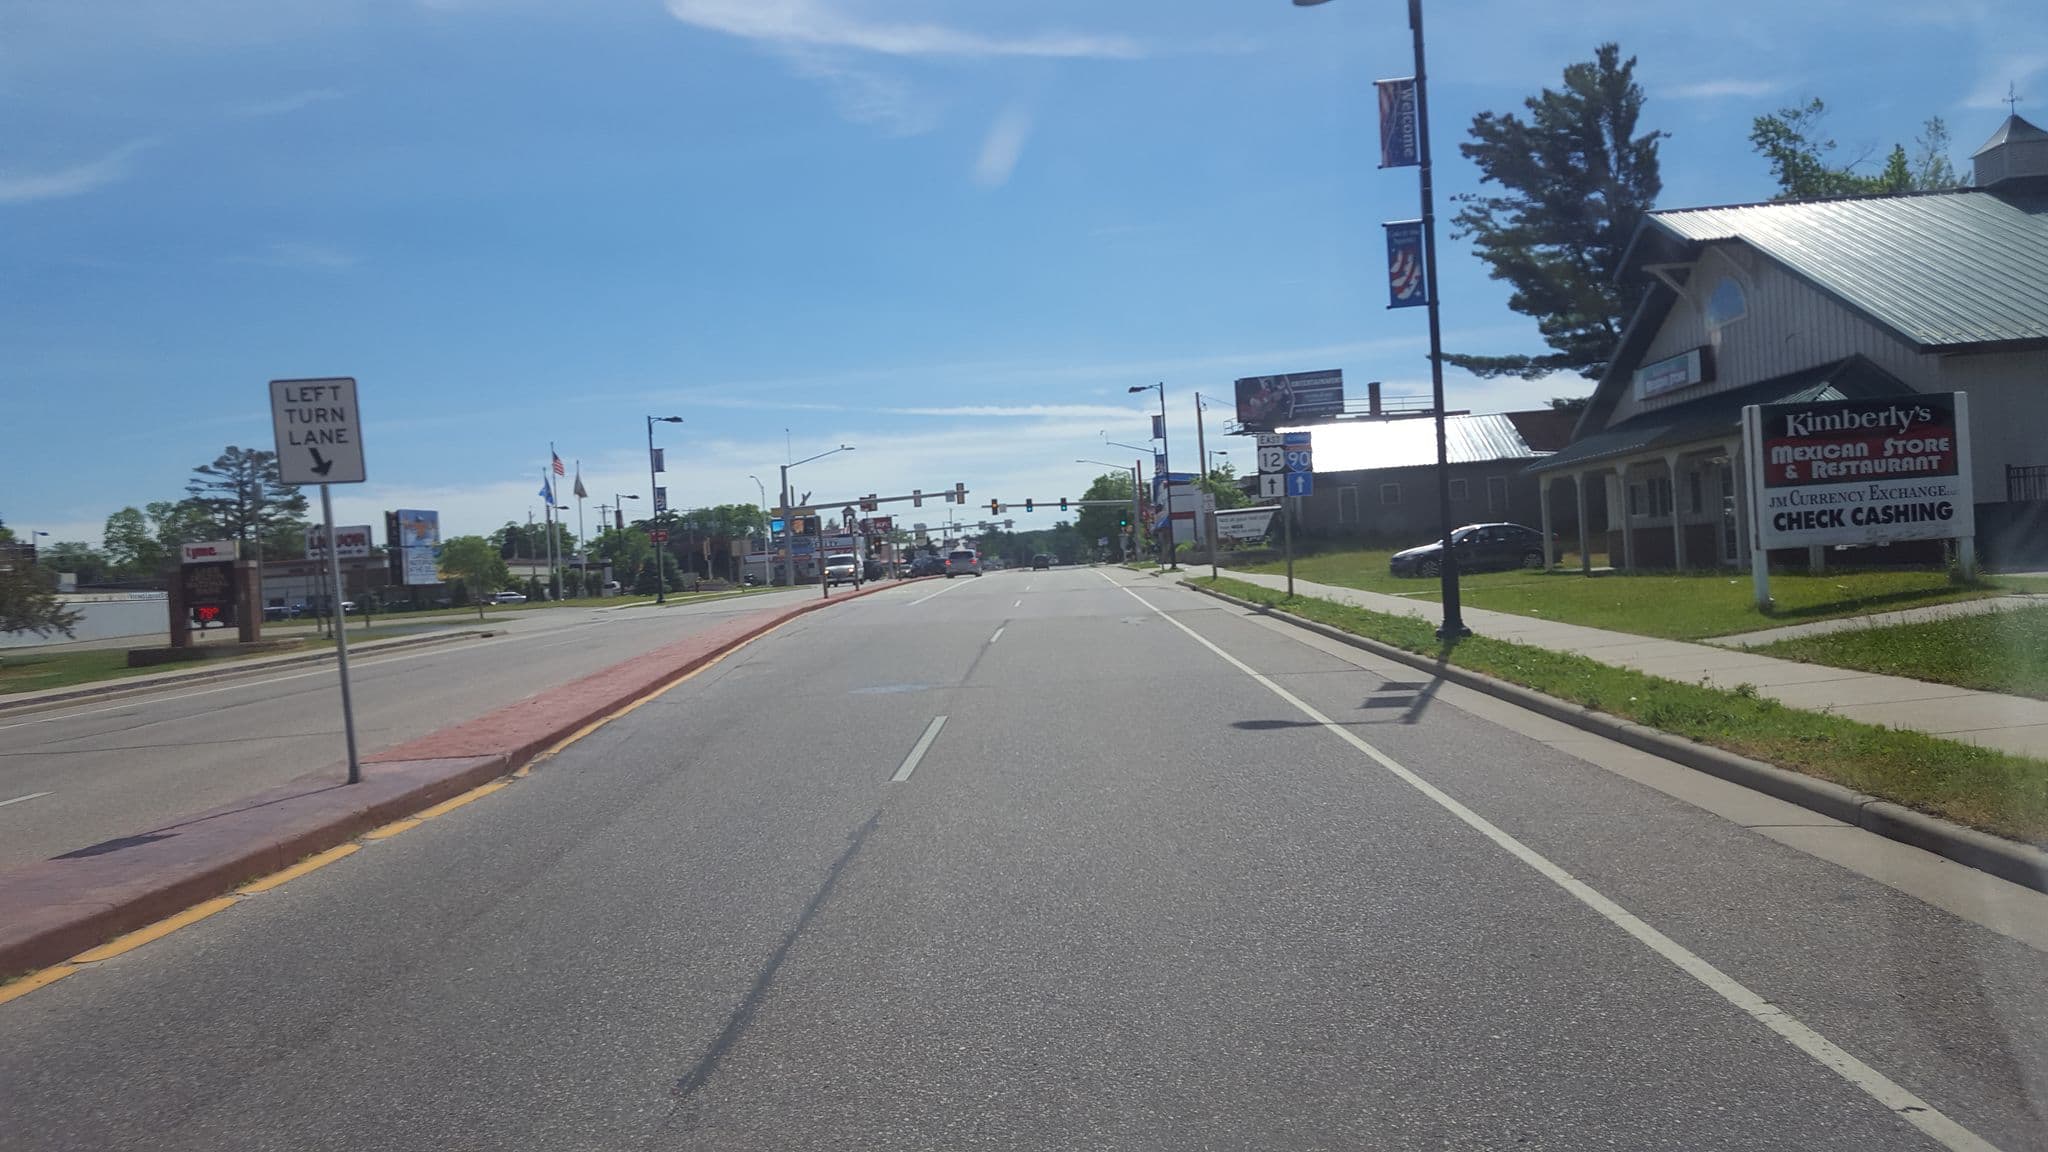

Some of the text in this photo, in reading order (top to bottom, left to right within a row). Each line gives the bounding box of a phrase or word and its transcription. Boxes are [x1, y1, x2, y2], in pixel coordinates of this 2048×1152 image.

[1400, 87, 1415, 158] Welcome
[285, 385, 341, 403] LEFT
[284, 407, 344, 424] TURN
[1785, 405, 1932, 438] Kimberly's
[288, 428, 349, 446] LANE
[1260, 435, 1280, 445] EAST
[1262, 452, 1281, 468] 12
[1287, 451, 1310, 467] 90
[1784, 465, 1799, 480] &
[1768, 497, 1788, 509] JM
[1790, 489, 1866, 507] CURRENCY
[1868, 484, 1947, 501] EXCHANGE
[1773, 501, 1954, 532] CHECK CASHING
